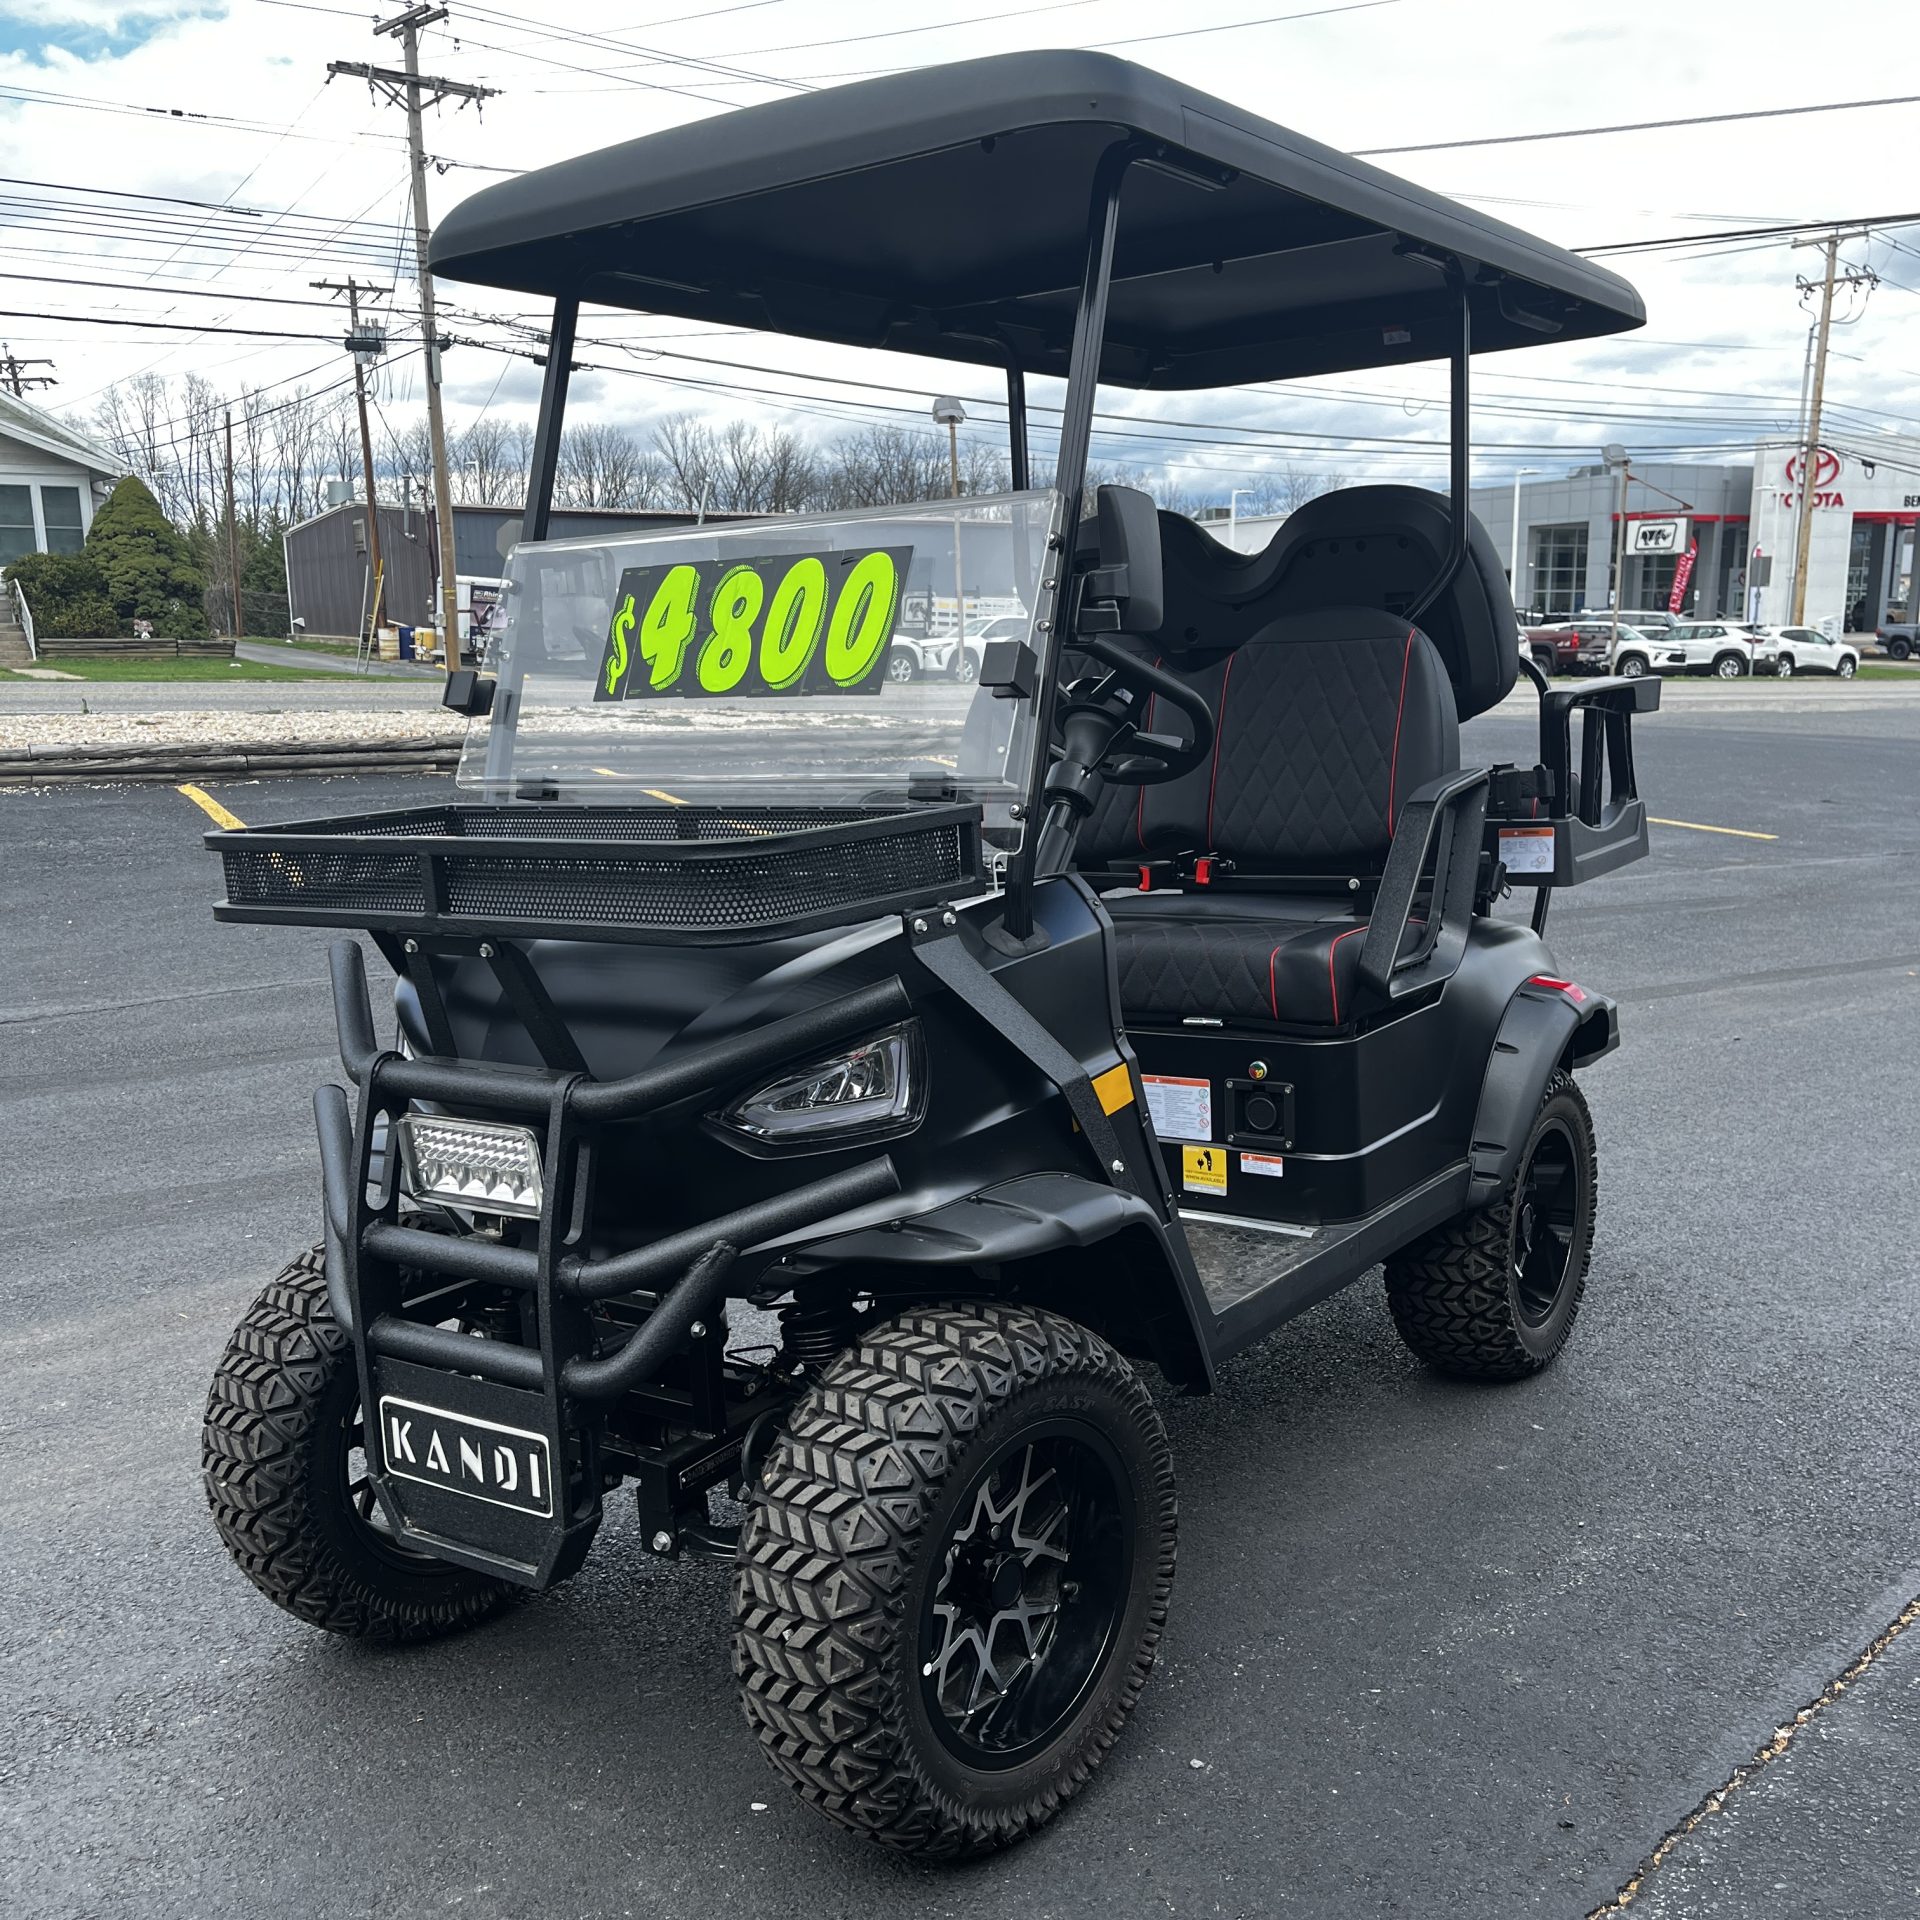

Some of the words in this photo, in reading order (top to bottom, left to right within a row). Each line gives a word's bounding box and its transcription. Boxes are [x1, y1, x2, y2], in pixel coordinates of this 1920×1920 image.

[1773, 492, 1844, 508] OOTA
[606, 551, 899, 695] $4800
[391, 1416, 541, 1498] KANDI
